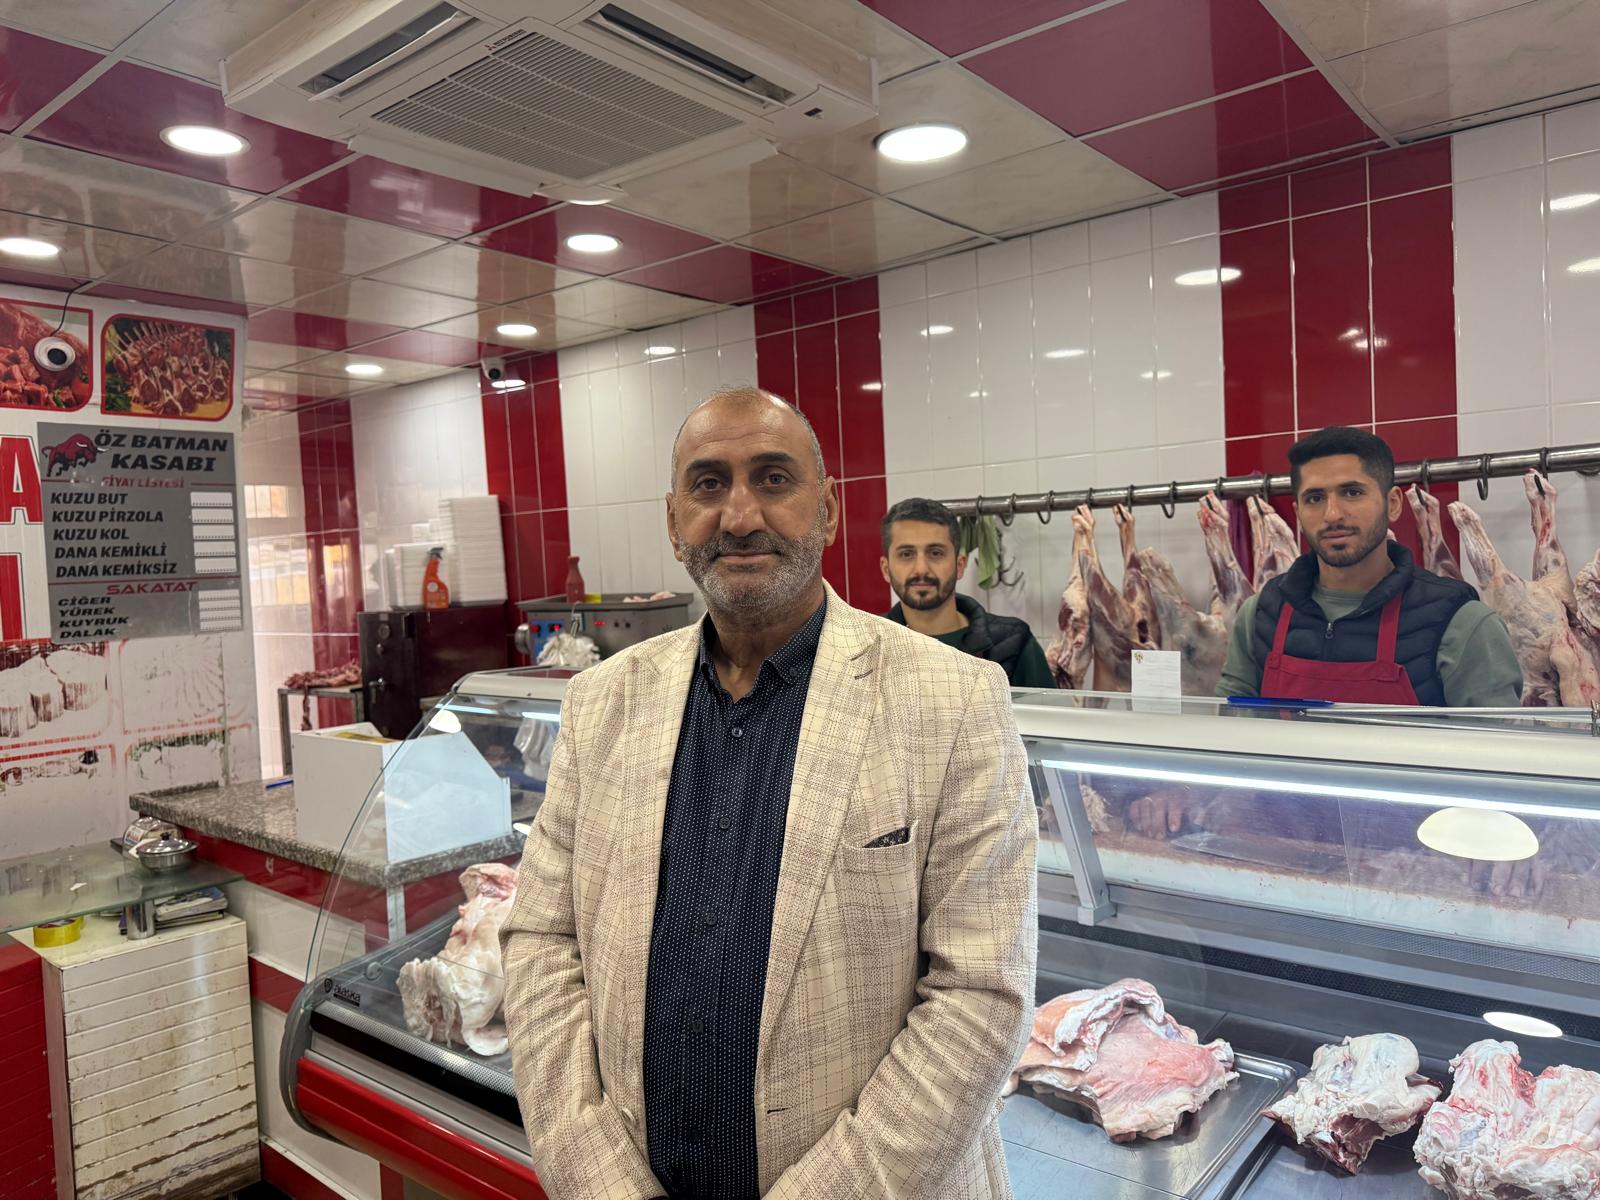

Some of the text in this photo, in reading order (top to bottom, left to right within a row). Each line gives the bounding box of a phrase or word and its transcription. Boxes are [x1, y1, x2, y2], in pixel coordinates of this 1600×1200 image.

[95, 429, 228, 452] ÖZ BATMAN
[111, 453, 217, 472] KASABI
[50, 492, 128, 505] KUZU BUT
[52, 507, 164, 522] KUZU PİRZOLA
[53, 528, 130, 541] KUZU KOL
[54, 542, 167, 559] DANA KEMİKLİ
[55, 559, 178, 578] DANA KEMİKSİZ
[106, 581, 198, 595] SAKATAT
[58, 595, 111, 607] CİĞER
[59, 606, 116, 617] YÜREK
[59, 616, 129, 628] KUYRUK
[59, 628, 116, 639] DALAK
